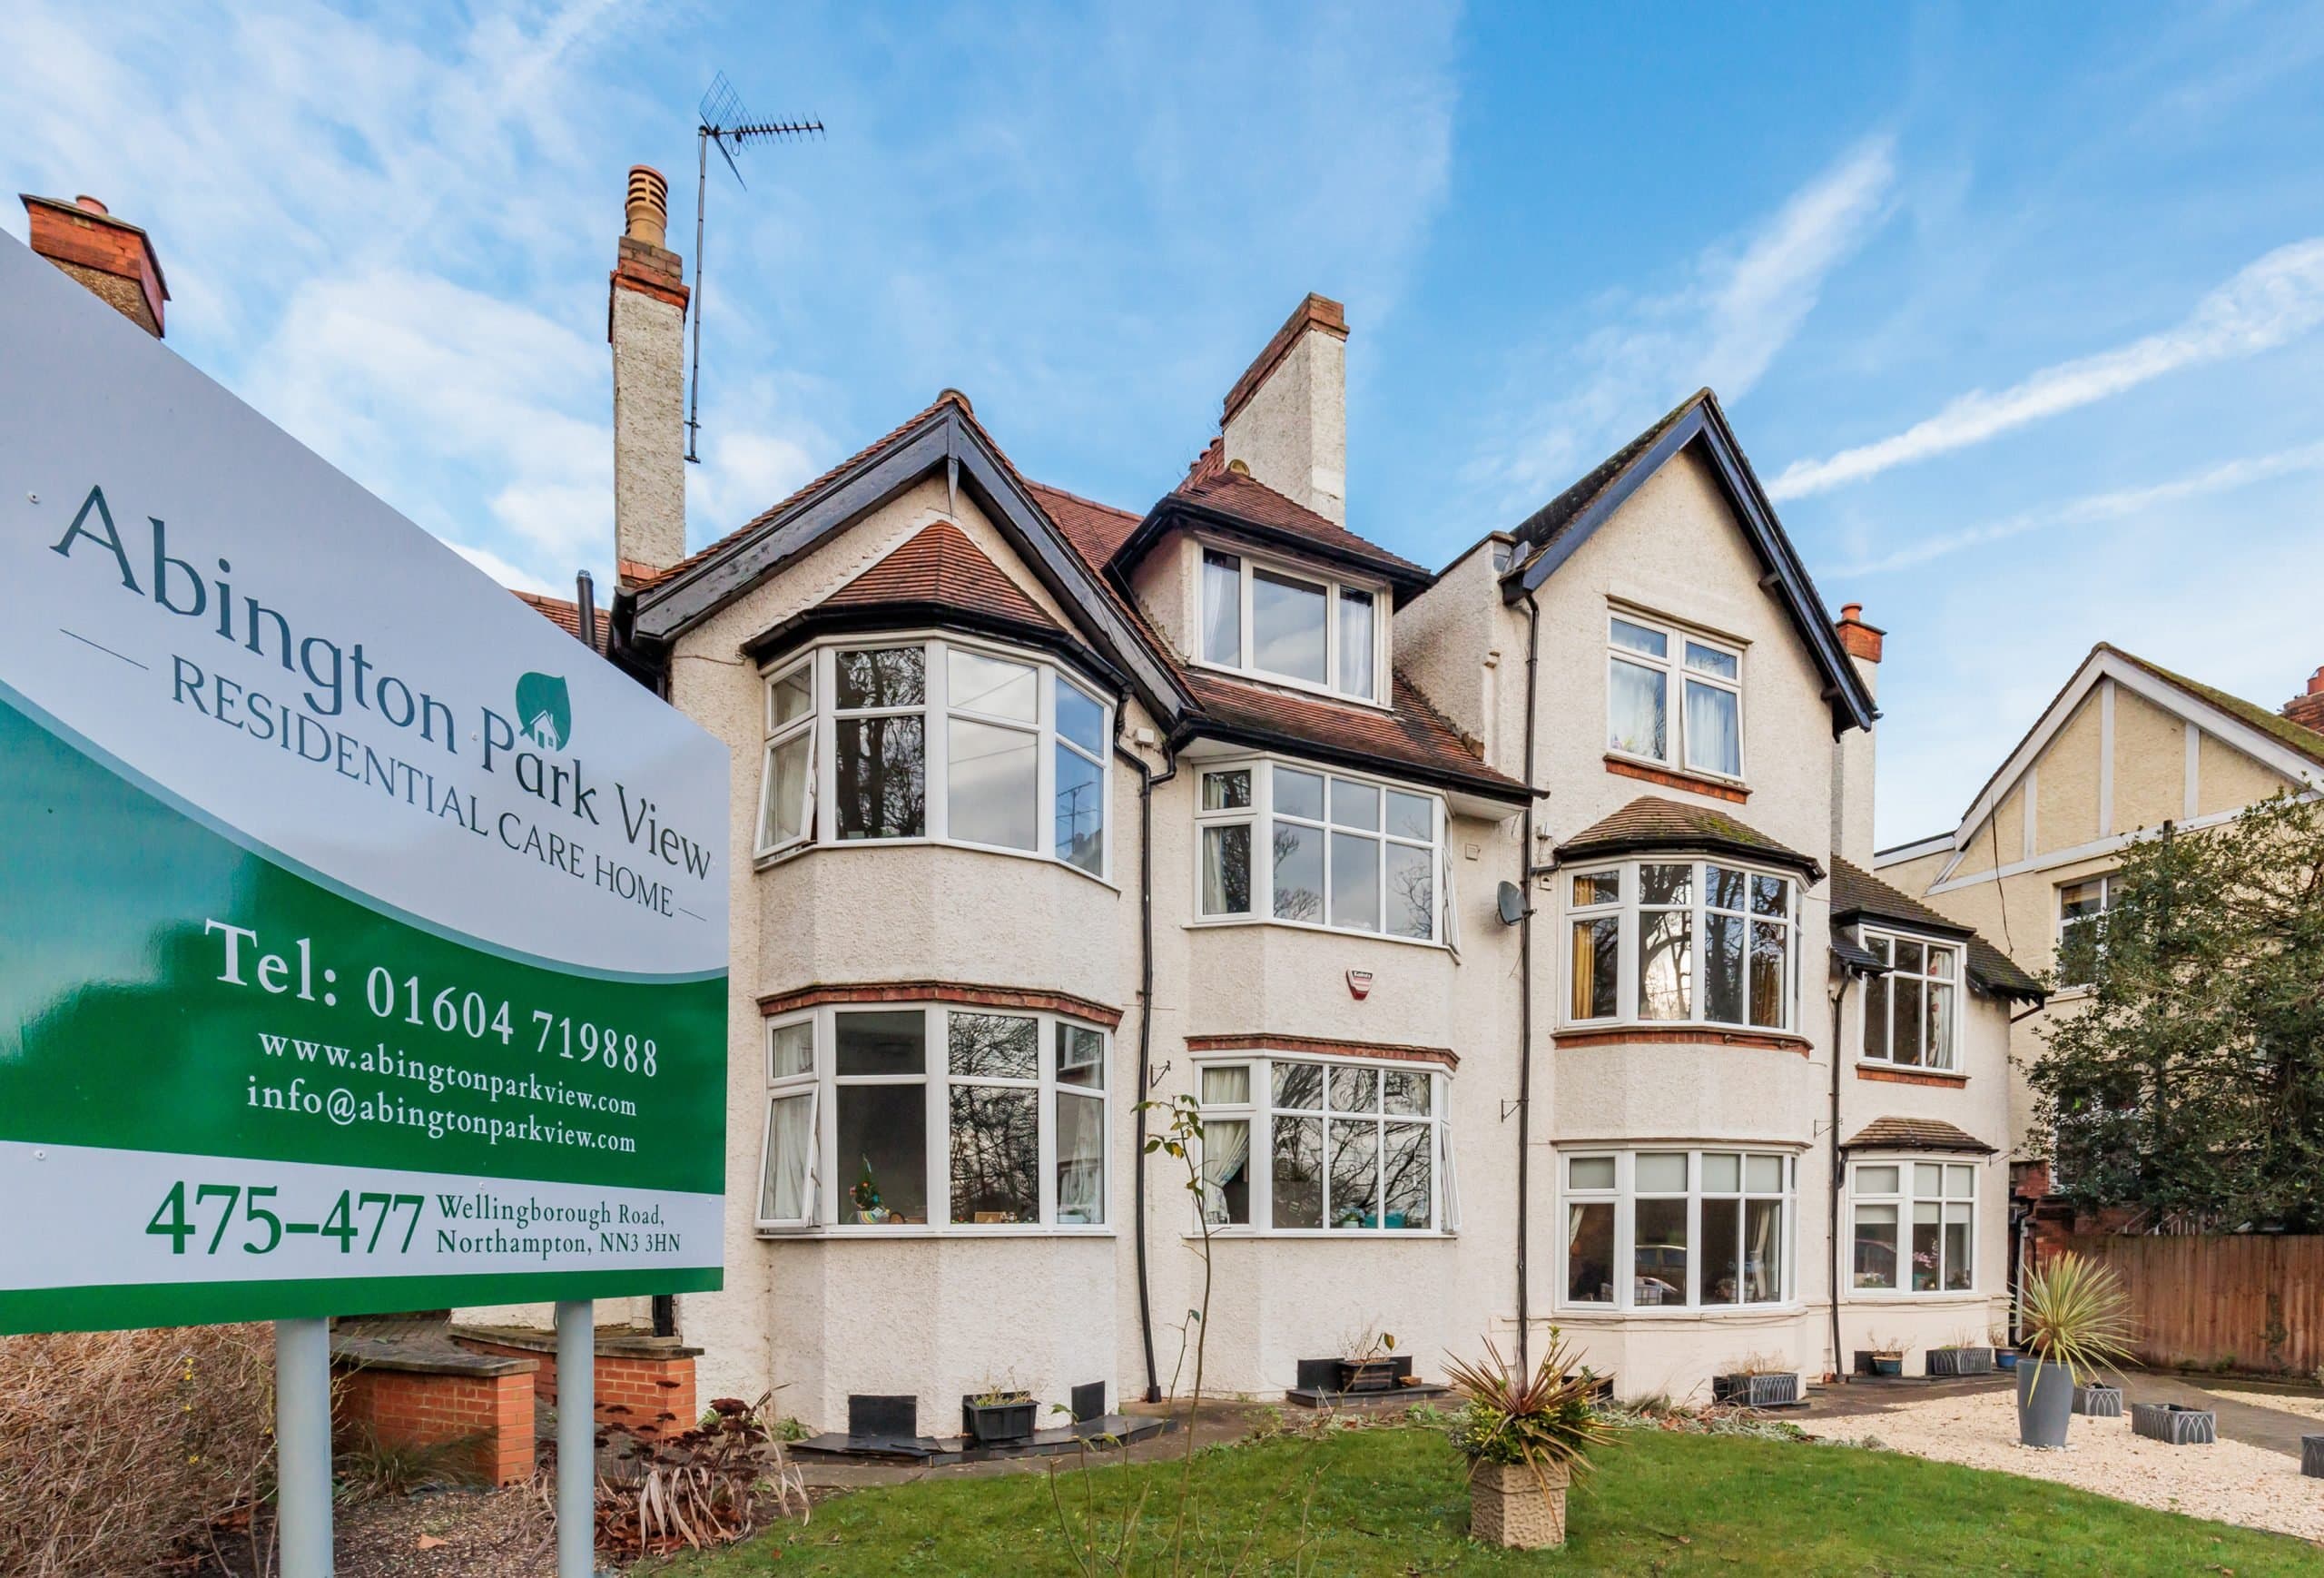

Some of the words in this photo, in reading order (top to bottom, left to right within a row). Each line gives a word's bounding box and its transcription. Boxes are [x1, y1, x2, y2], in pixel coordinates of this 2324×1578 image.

[49, 485, 458, 754] Abington
[481, 706, 599, 825] Park
[615, 783, 710, 881] View
[172, 654, 488, 836] RESIDENTIAL
[498, 813, 585, 879] CARE
[596, 854, 673, 917] HOME
[205, 918, 337, 1006] Tel:
[367, 967, 513, 1044] 01604
[533, 1011, 656, 1077] 719888
[248, 1076, 636, 1152] info@abingtonparkview.com
[259, 1033, 636, 1116] www.abingtonparkview.com
[145, 1181, 425, 1254] 475-477
[436, 1193, 611, 1231] Wellingborough
[618, 1204, 664, 1228] Road,
[437, 1228, 591, 1261] Northampton,
[600, 1232, 638, 1253] NN3
[645, 1233, 680, 1253] 3HN
